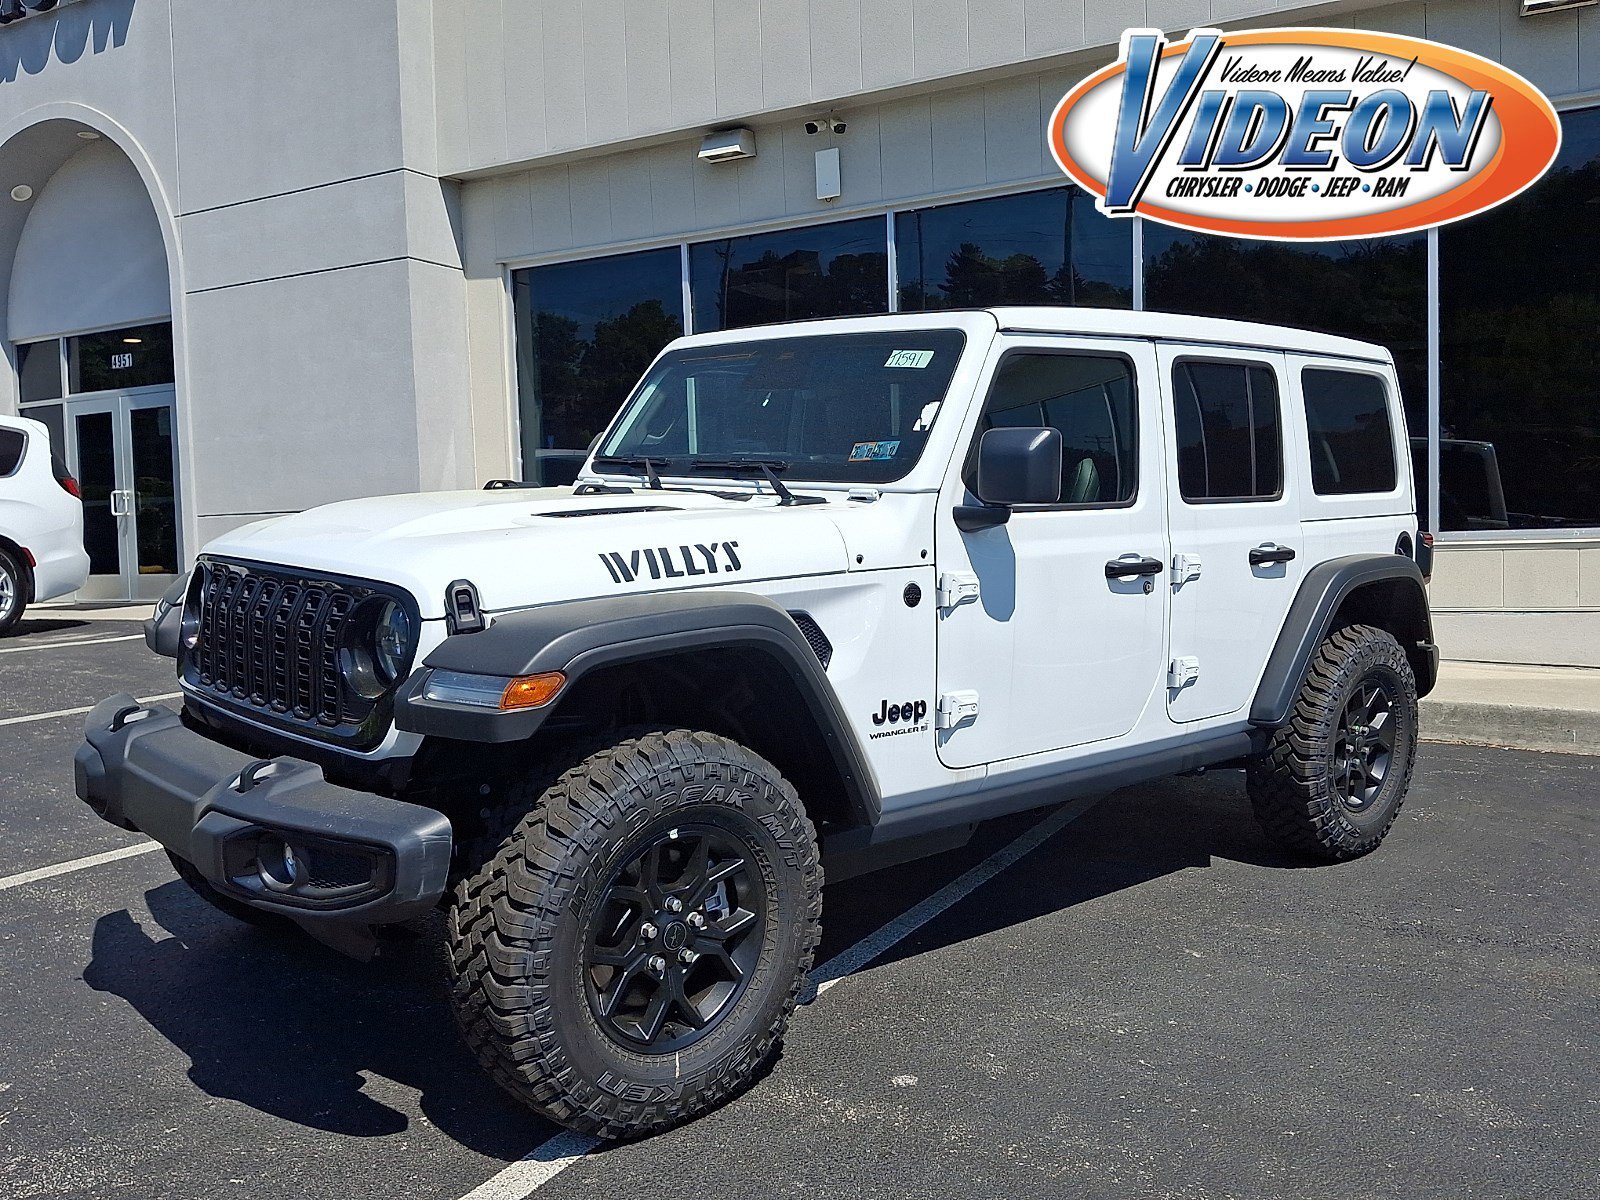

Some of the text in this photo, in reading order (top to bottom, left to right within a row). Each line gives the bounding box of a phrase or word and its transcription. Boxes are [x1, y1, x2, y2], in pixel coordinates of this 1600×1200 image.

[112, 354, 132, 368] 4951
[598, 541, 741, 583] WILLYS
[872, 699, 927, 726] Jeep
[869, 726, 919, 740] WRANGLER
